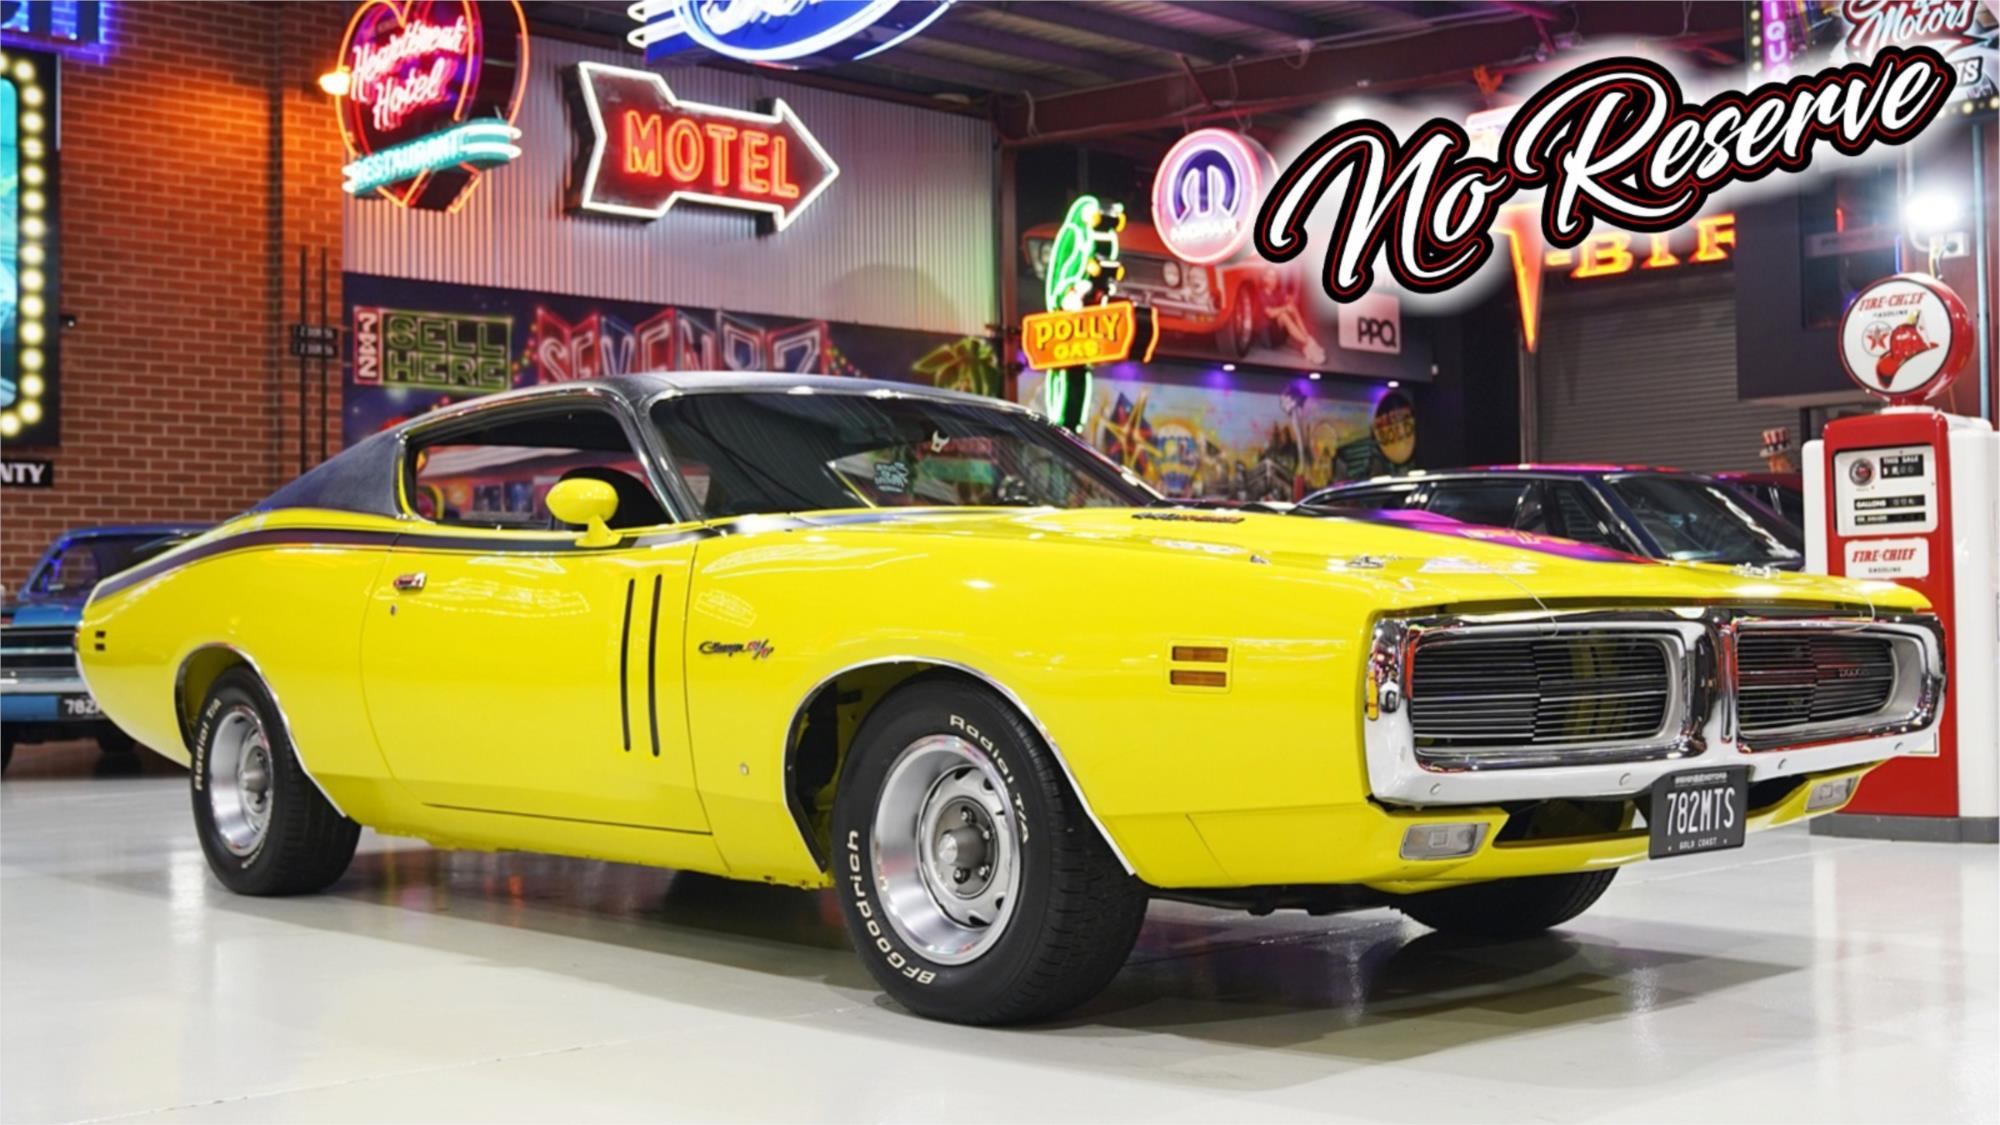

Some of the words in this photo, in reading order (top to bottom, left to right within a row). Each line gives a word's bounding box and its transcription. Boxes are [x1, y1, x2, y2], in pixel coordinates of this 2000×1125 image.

[372, 57, 446, 130] Hotel
[624, 110, 799, 199] MOTEL
[388, 315, 505, 355] SELL
[1035, 312, 1119, 350] POLLY
[1053, 341, 1099, 360] GAS
[1357, 316, 1397, 348] PPQ
[388, 351, 505, 386] HERE
[0, 461, 45, 483] NTY
[950, 714, 1014, 784] Radial
[1014, 793, 1030, 844] T/A
[1666, 786, 1736, 836] 782MTS
[847, 831, 937, 985] BFGoodrich
